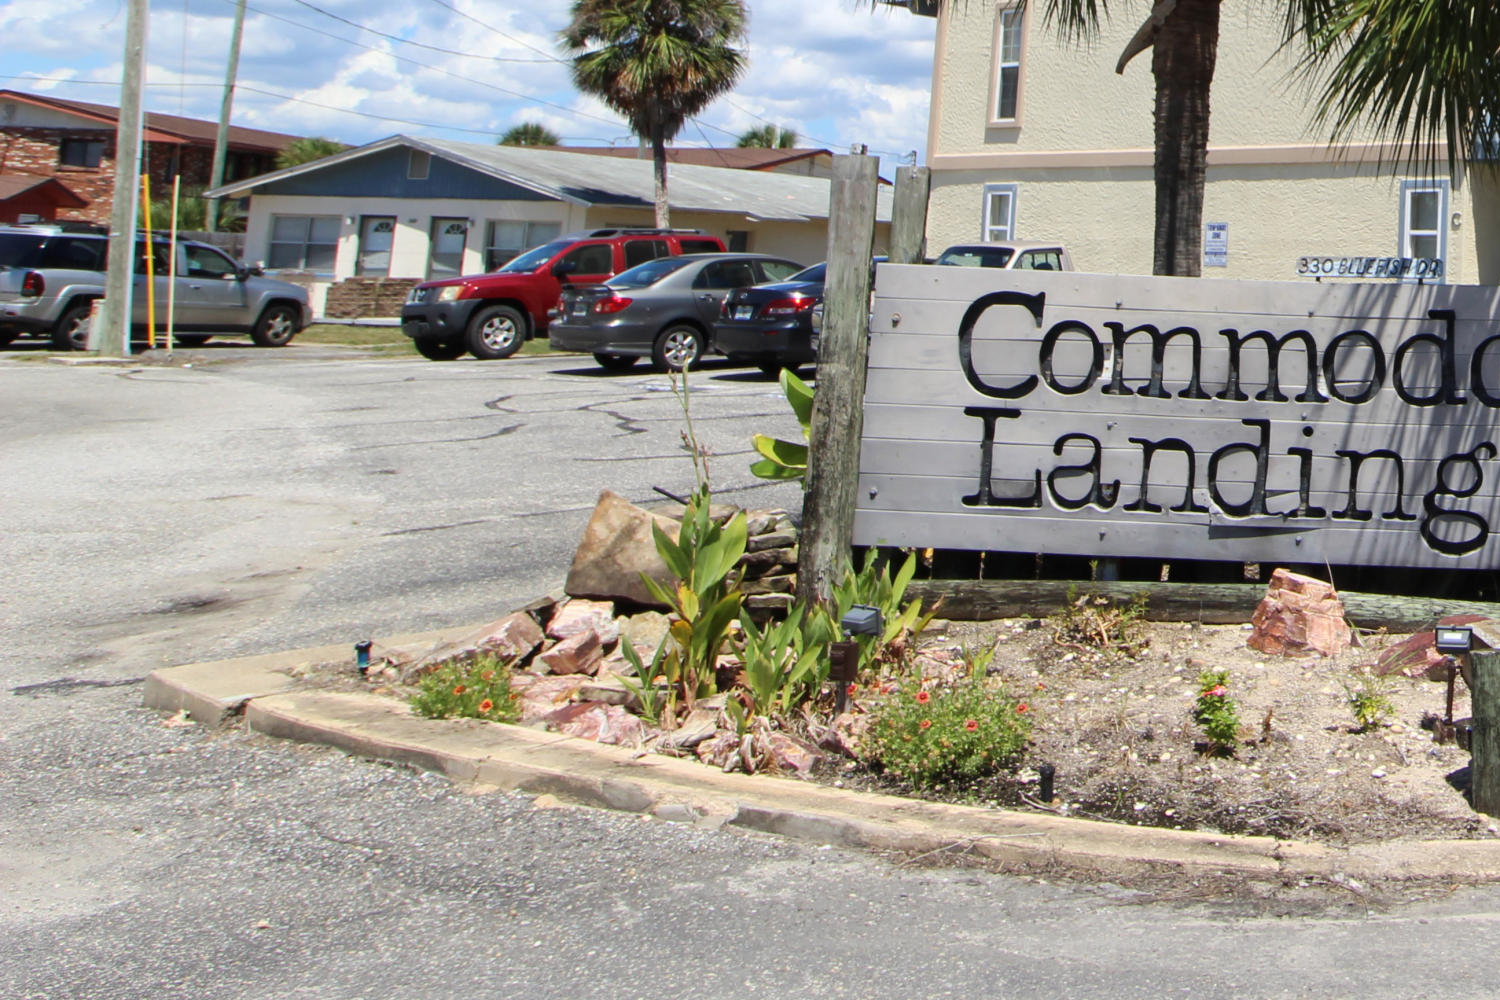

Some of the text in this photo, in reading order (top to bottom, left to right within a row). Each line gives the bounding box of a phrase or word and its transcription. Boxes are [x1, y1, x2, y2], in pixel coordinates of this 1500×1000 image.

[1298, 258, 1333, 274] 330
[1337, 257, 1413, 276] BLUEFISH
[960, 406, 1497, 555] Landing
